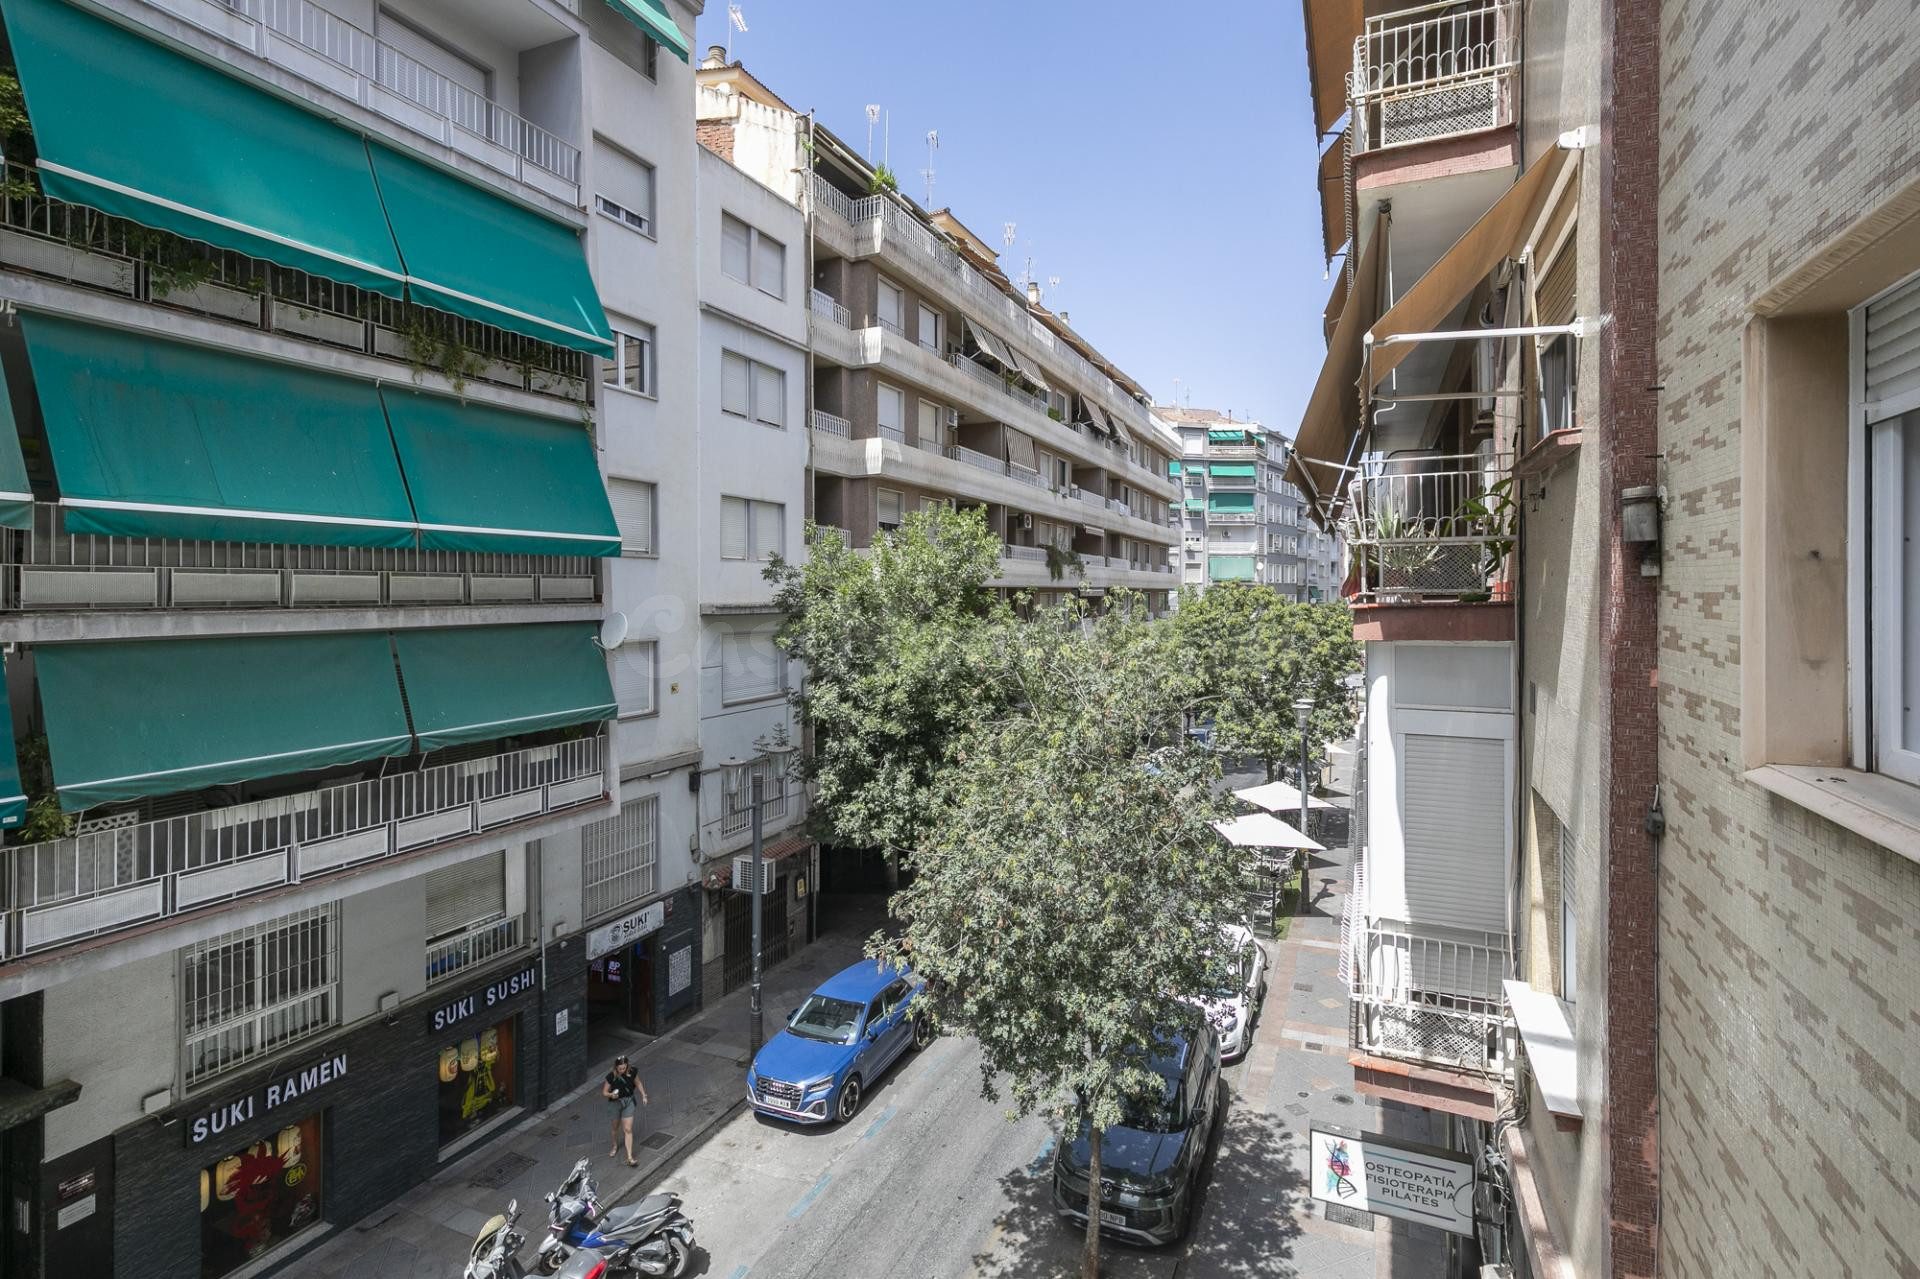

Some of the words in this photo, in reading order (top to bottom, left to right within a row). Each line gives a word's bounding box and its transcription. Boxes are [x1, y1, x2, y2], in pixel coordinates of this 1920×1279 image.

[434, 996, 475, 1031] SUKI
[486, 968, 535, 1007] SUSHI
[192, 1095, 254, 1143] SUKI
[266, 1054, 348, 1109] RAMEN
[1365, 1161, 1456, 1190] OSTEOPATÍA
[1365, 1173, 1456, 1201] FISIOTERAPIA
[1381, 1187, 1439, 1208] PILATES
